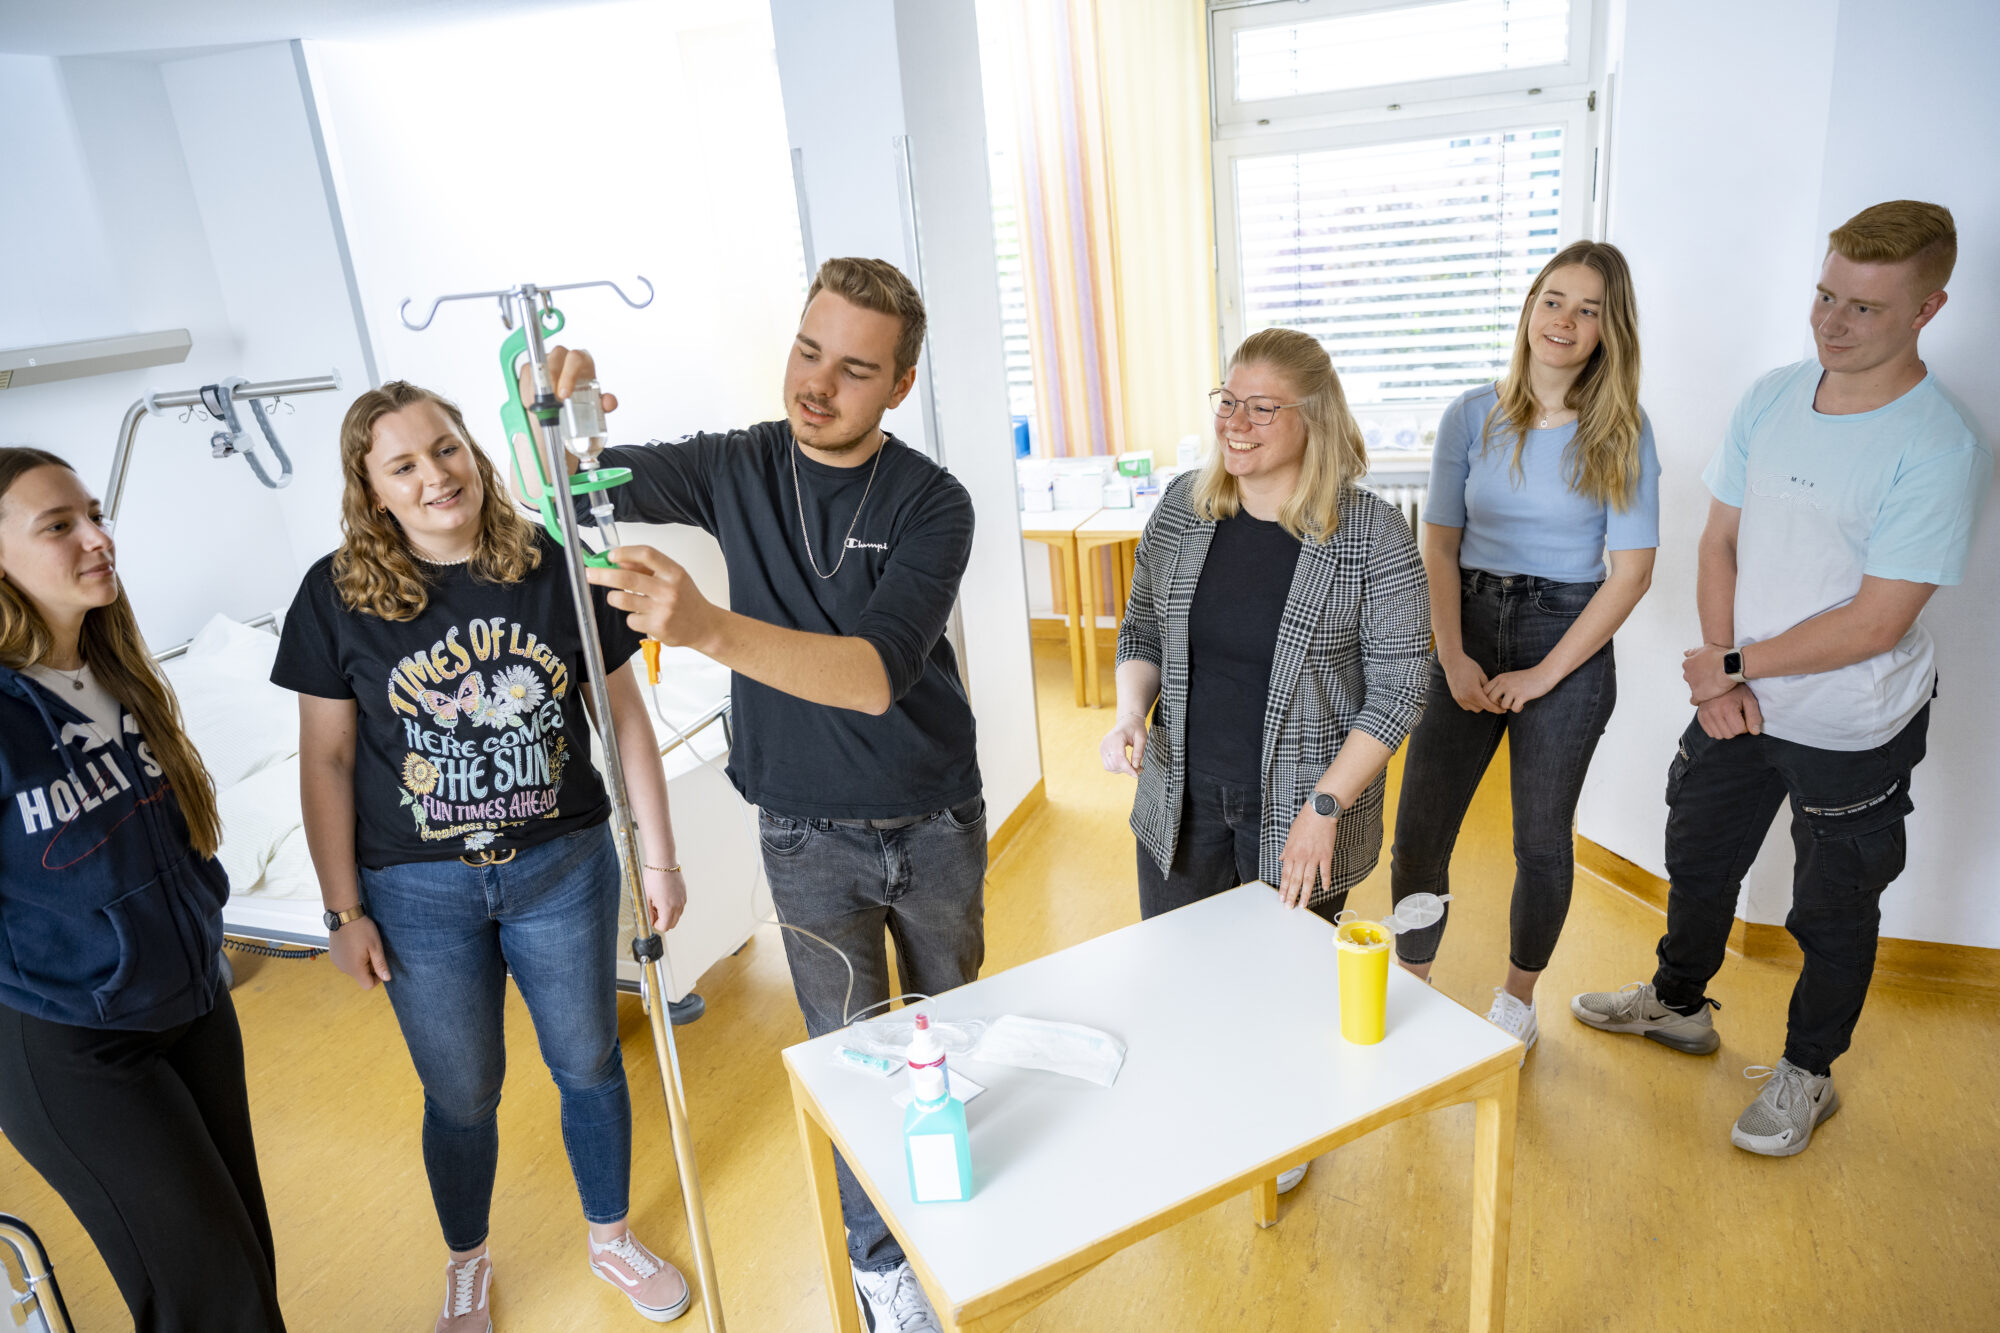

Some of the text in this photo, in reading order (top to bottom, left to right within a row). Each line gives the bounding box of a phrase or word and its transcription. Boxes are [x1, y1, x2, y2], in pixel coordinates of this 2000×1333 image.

[844, 537, 888, 553] Champi
[388, 617, 569, 717] TIMES OF LIGHT
[402, 693, 564, 758] HERE COMES
[16, 742, 163, 835] HOLLIS
[430, 741, 551, 802] THE SUN
[420, 820, 498, 842] Happiness is
[422, 795, 453, 821] FUN
[455, 797, 507, 820] TIMES
[509, 788, 557, 818] AHEAD
